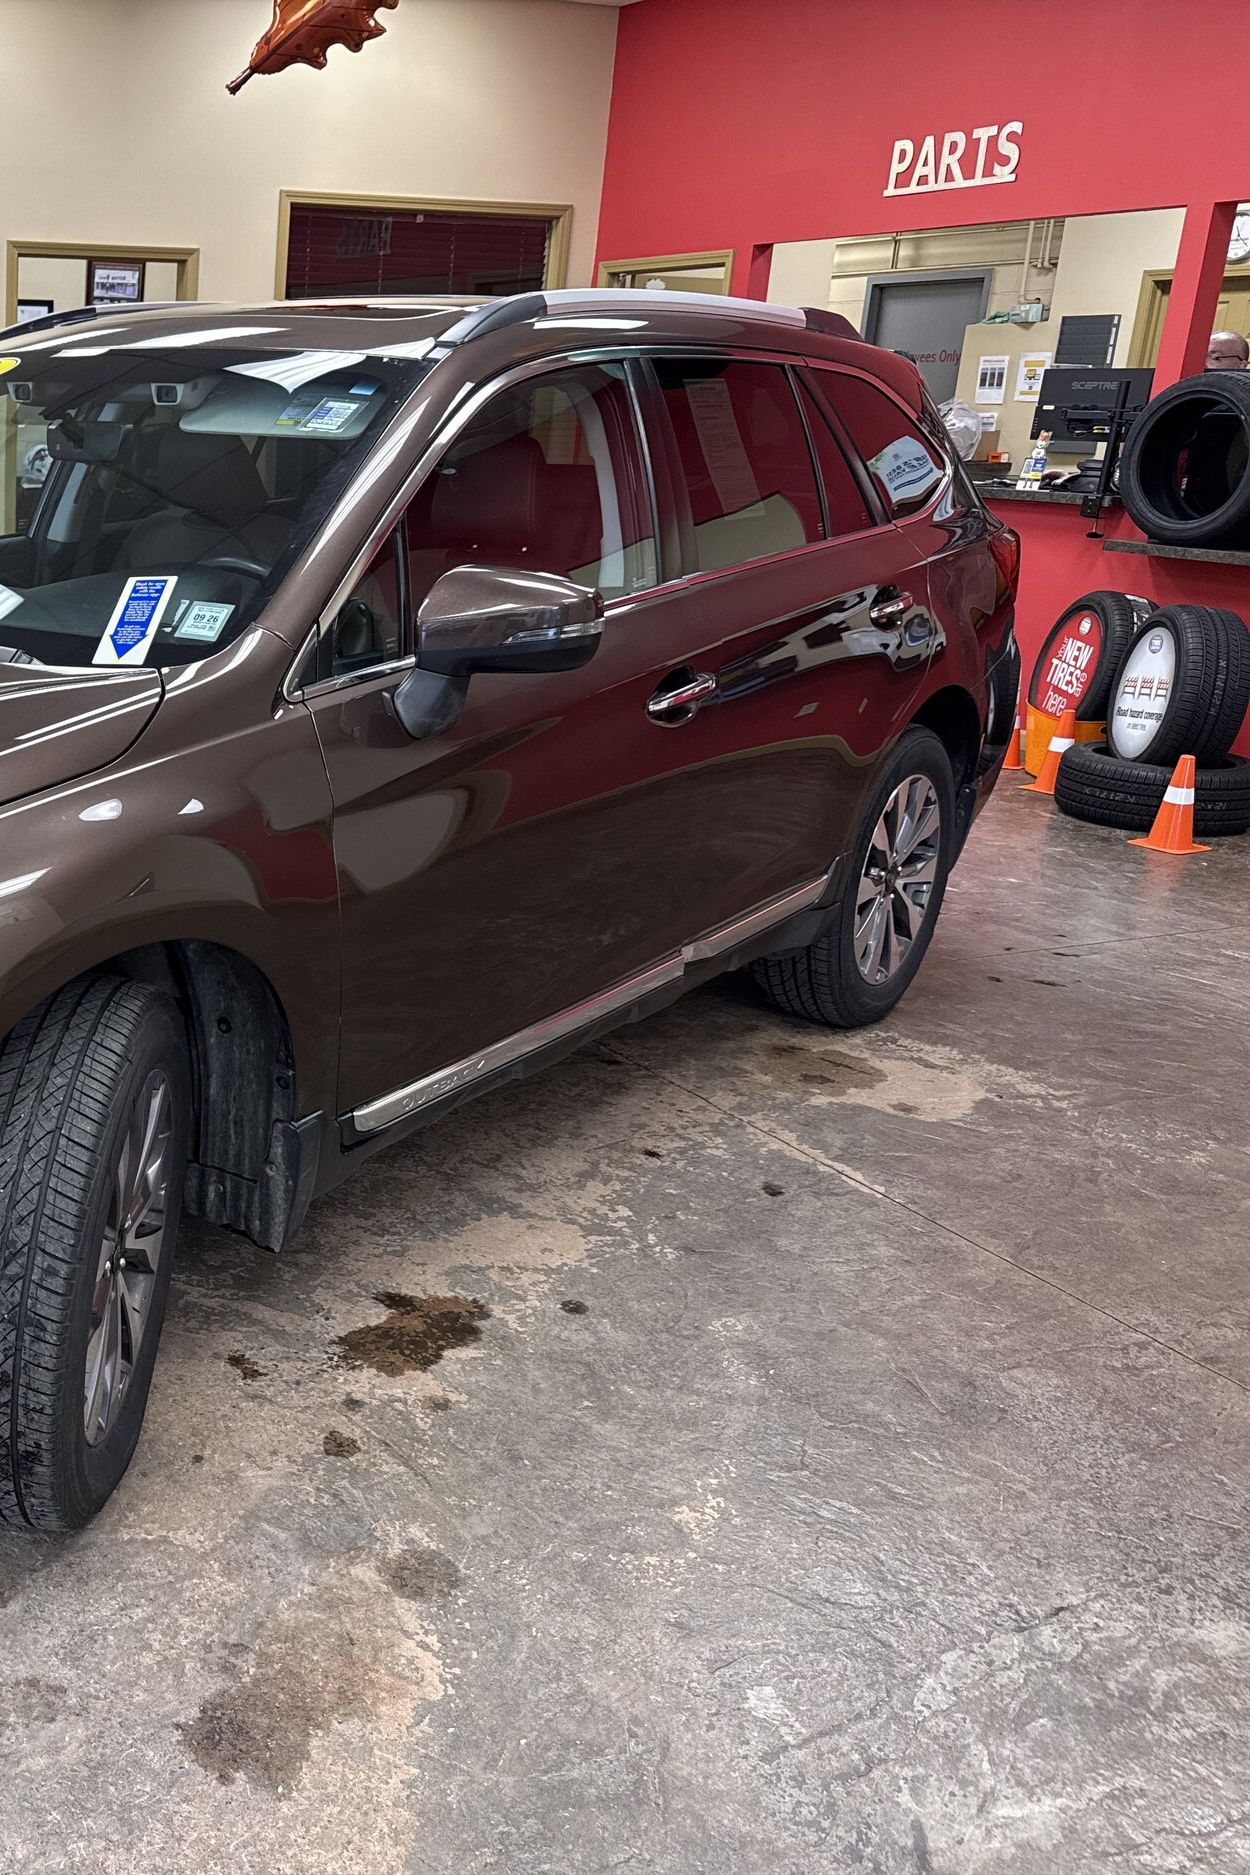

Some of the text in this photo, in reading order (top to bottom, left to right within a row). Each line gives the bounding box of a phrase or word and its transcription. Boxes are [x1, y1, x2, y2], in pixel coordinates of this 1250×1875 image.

[884, 120, 1024, 193] PARTS
[939, 349, 961, 366] Only
[1071, 381, 1118, 390] SCEPTRE
[193, 613, 220, 623] 09 26
[1057, 636, 1068, 658] your
[1062, 638, 1094, 670] NEW
[1047, 658, 1081, 694] TIRES
[1074, 672, 1088, 697] are
[1042, 685, 1067, 716] here
[1116, 706, 1163, 723] Road hazard coverage
